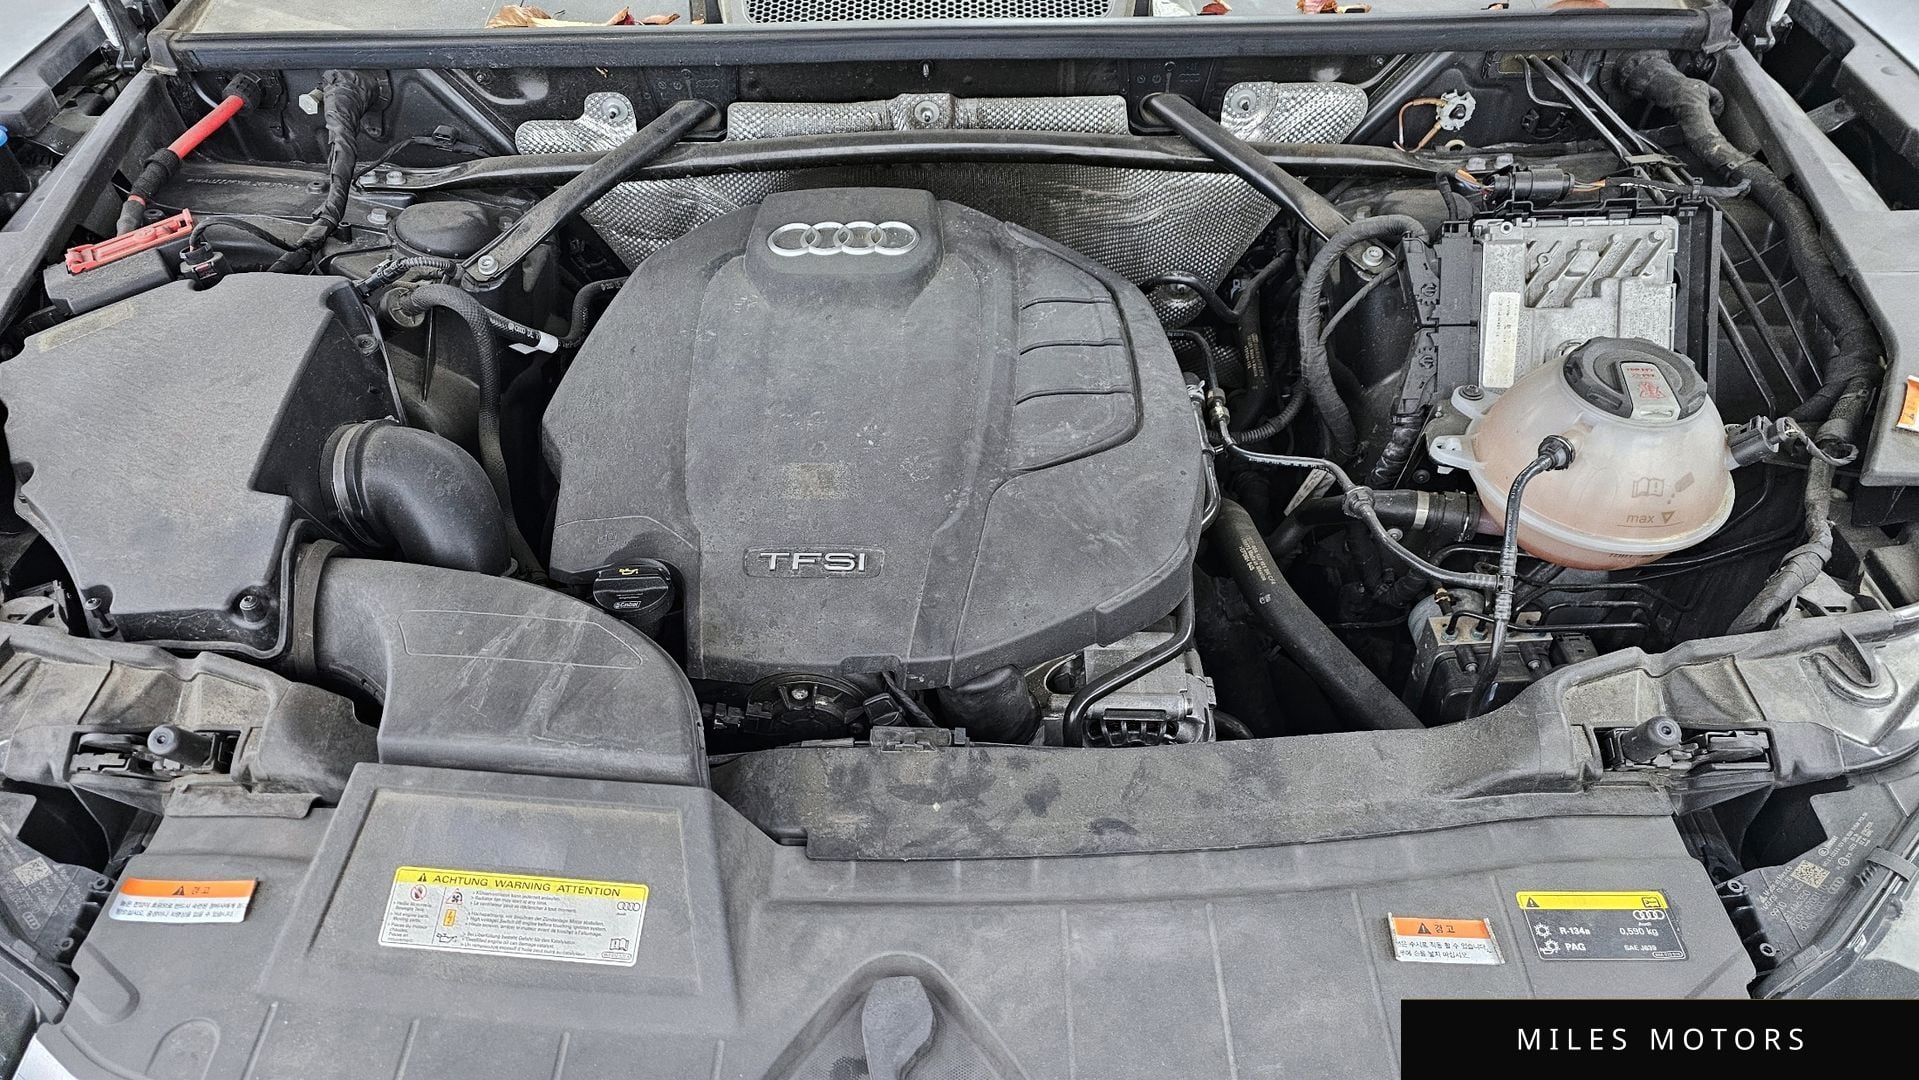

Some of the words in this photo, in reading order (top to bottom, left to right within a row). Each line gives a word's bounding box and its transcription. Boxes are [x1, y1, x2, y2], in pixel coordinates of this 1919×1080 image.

[1626, 514, 1655, 524] max
[760, 552, 866, 572] TFSI
[432, 875, 488, 887] ACHTUNG
[495, 879, 551, 892] WARNING
[556, 884, 621, 897] ATTENTION
[1559, 926, 1591, 935] R-134a
[1619, 927, 1645, 936] 0,590
[1646, 927, 1659, 937] kg
[1564, 942, 1587, 951] PAG
